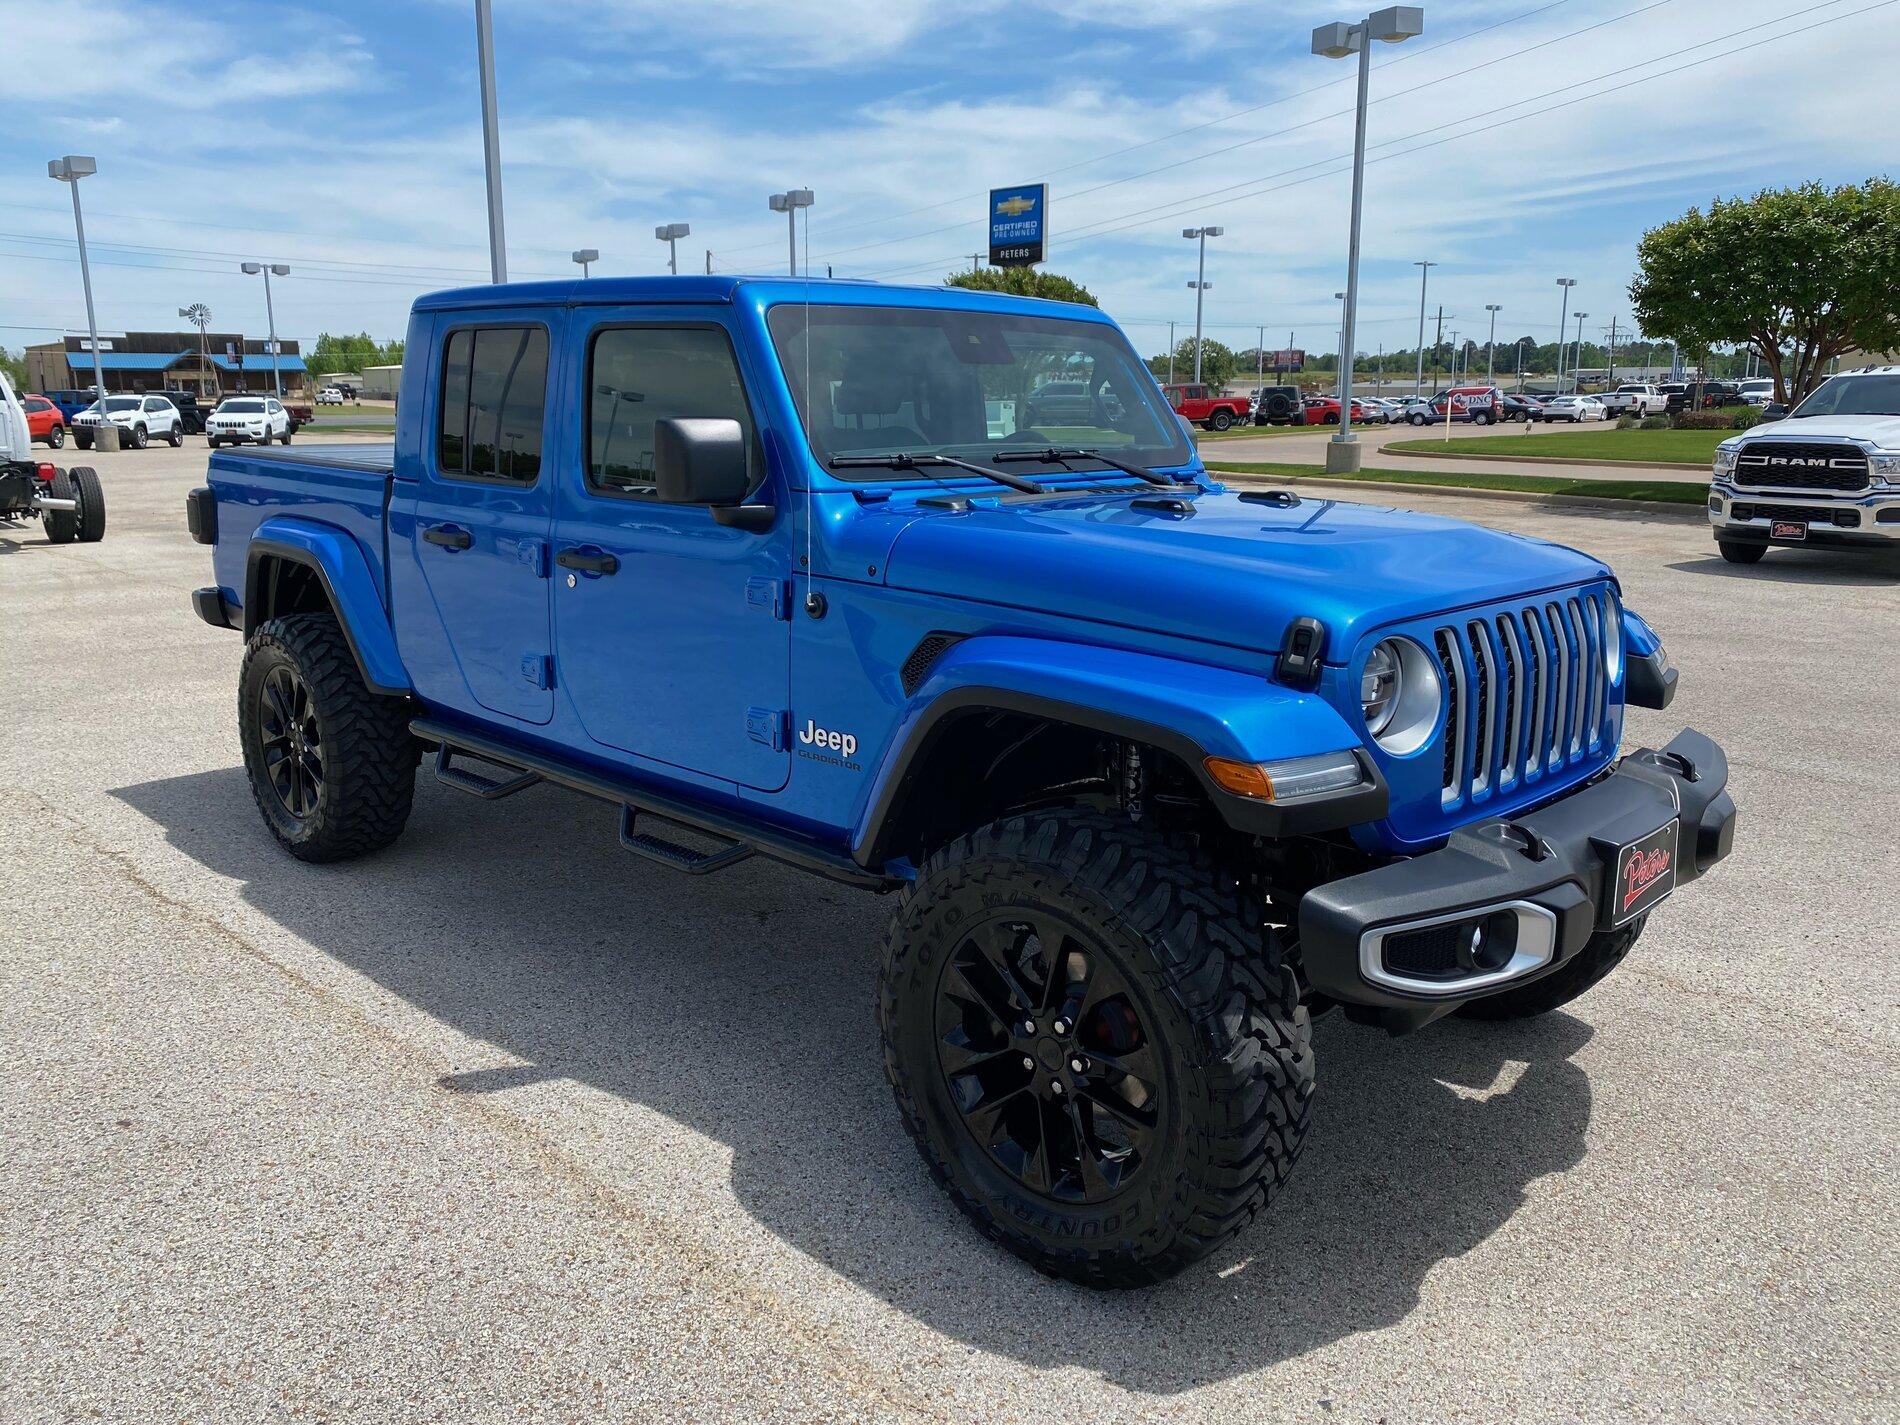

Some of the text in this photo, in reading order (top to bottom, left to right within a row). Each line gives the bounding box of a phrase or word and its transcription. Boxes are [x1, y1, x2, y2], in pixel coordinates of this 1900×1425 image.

[993, 221, 1037, 231] CERTIFIED
[995, 229, 1035, 238] PRE-OWNED
[1000, 248, 1030, 258] PETERS
[1469, 395, 1491, 404] DNC
[1771, 457, 1825, 466] RAM
[799, 719, 857, 758] Jeep
[799, 750, 861, 771] GLADIATOR
[1623, 848, 1670, 897] Peters
[908, 906, 964, 992] TOYO
[990, 1194, 1141, 1240] COUNTRY
